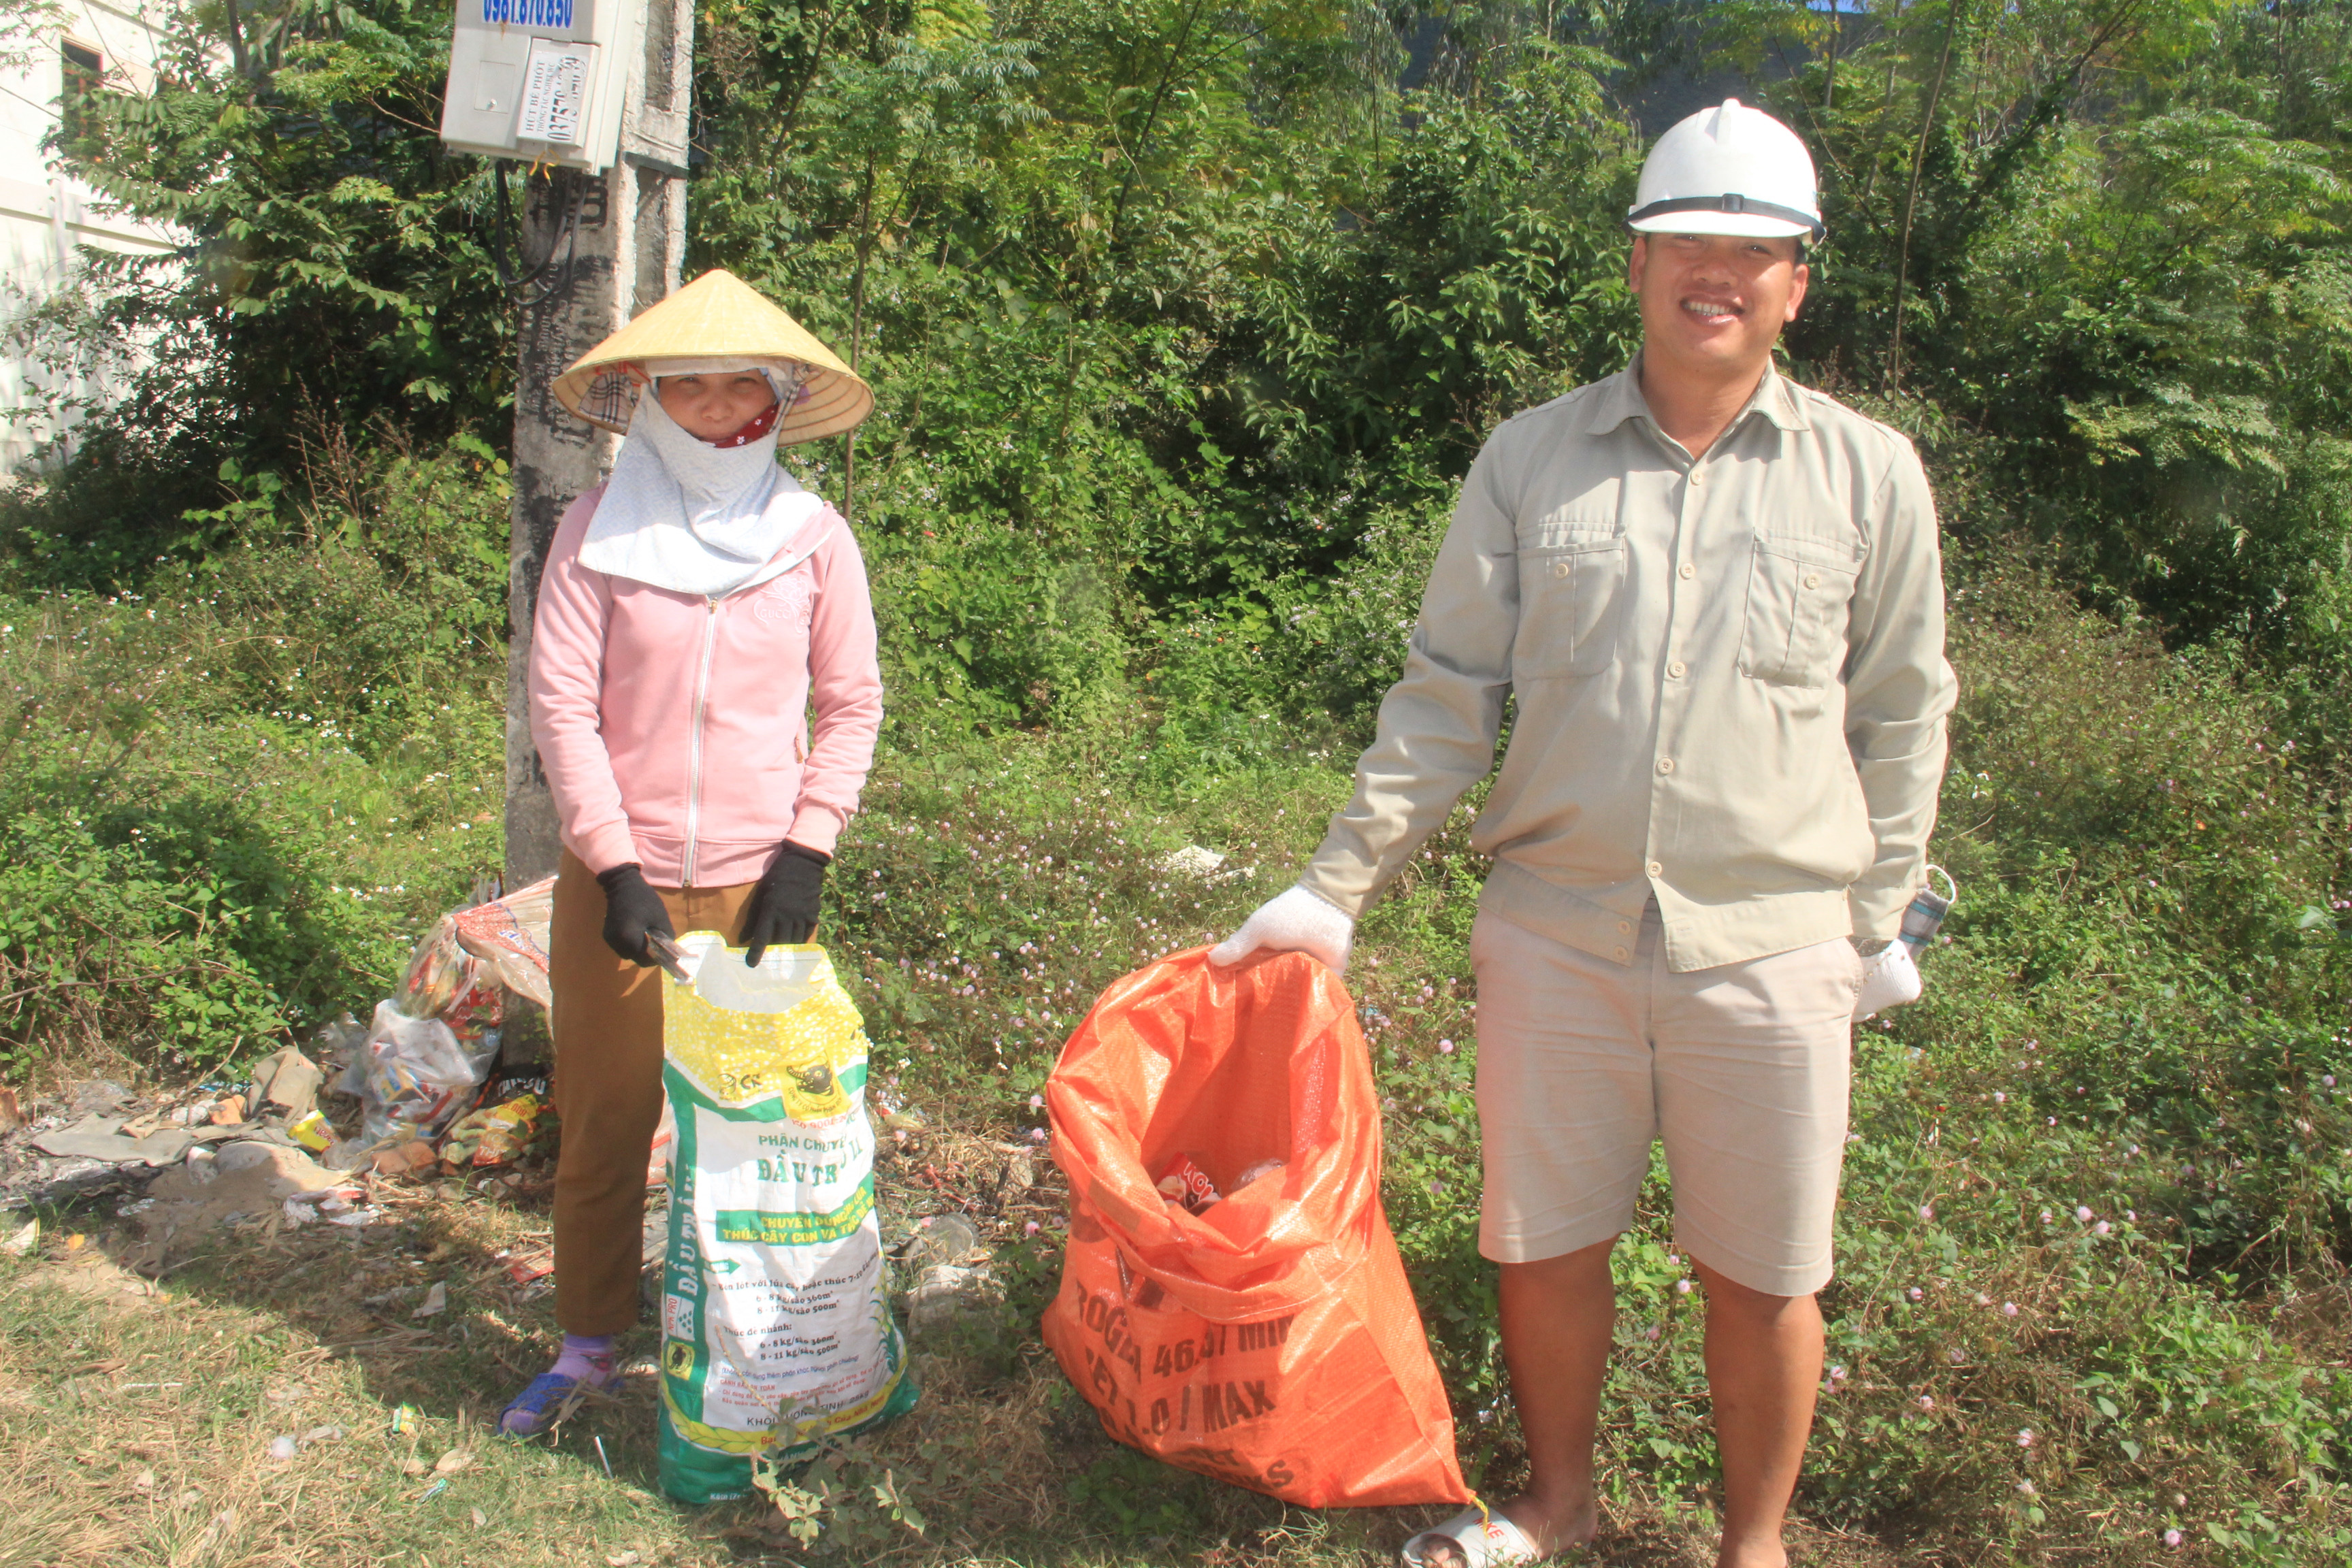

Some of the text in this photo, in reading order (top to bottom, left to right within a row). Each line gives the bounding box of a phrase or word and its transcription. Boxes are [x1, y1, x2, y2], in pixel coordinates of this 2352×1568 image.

[760, 608, 791, 619] GUCCI
[758, 1133, 799, 1148] PHÂN
[757, 1149, 808, 1183] ĐẦU
[760, 1215, 813, 1229] CHUYÊN
[722, 1228, 759, 1241] THÚC
[760, 1230, 788, 1243] CÂY
[791, 1231, 819, 1243] CON
[752, 1279, 767, 1288] với
[824, 1276, 847, 1285] thúc
[666, 1298, 678, 1315] PRO
[761, 1323, 792, 1335] nhánh:
[760, 1352, 766, 1360] 8
[774, 1352, 783, 1360] 11
[1202, 1380, 1277, 1434] MAX
